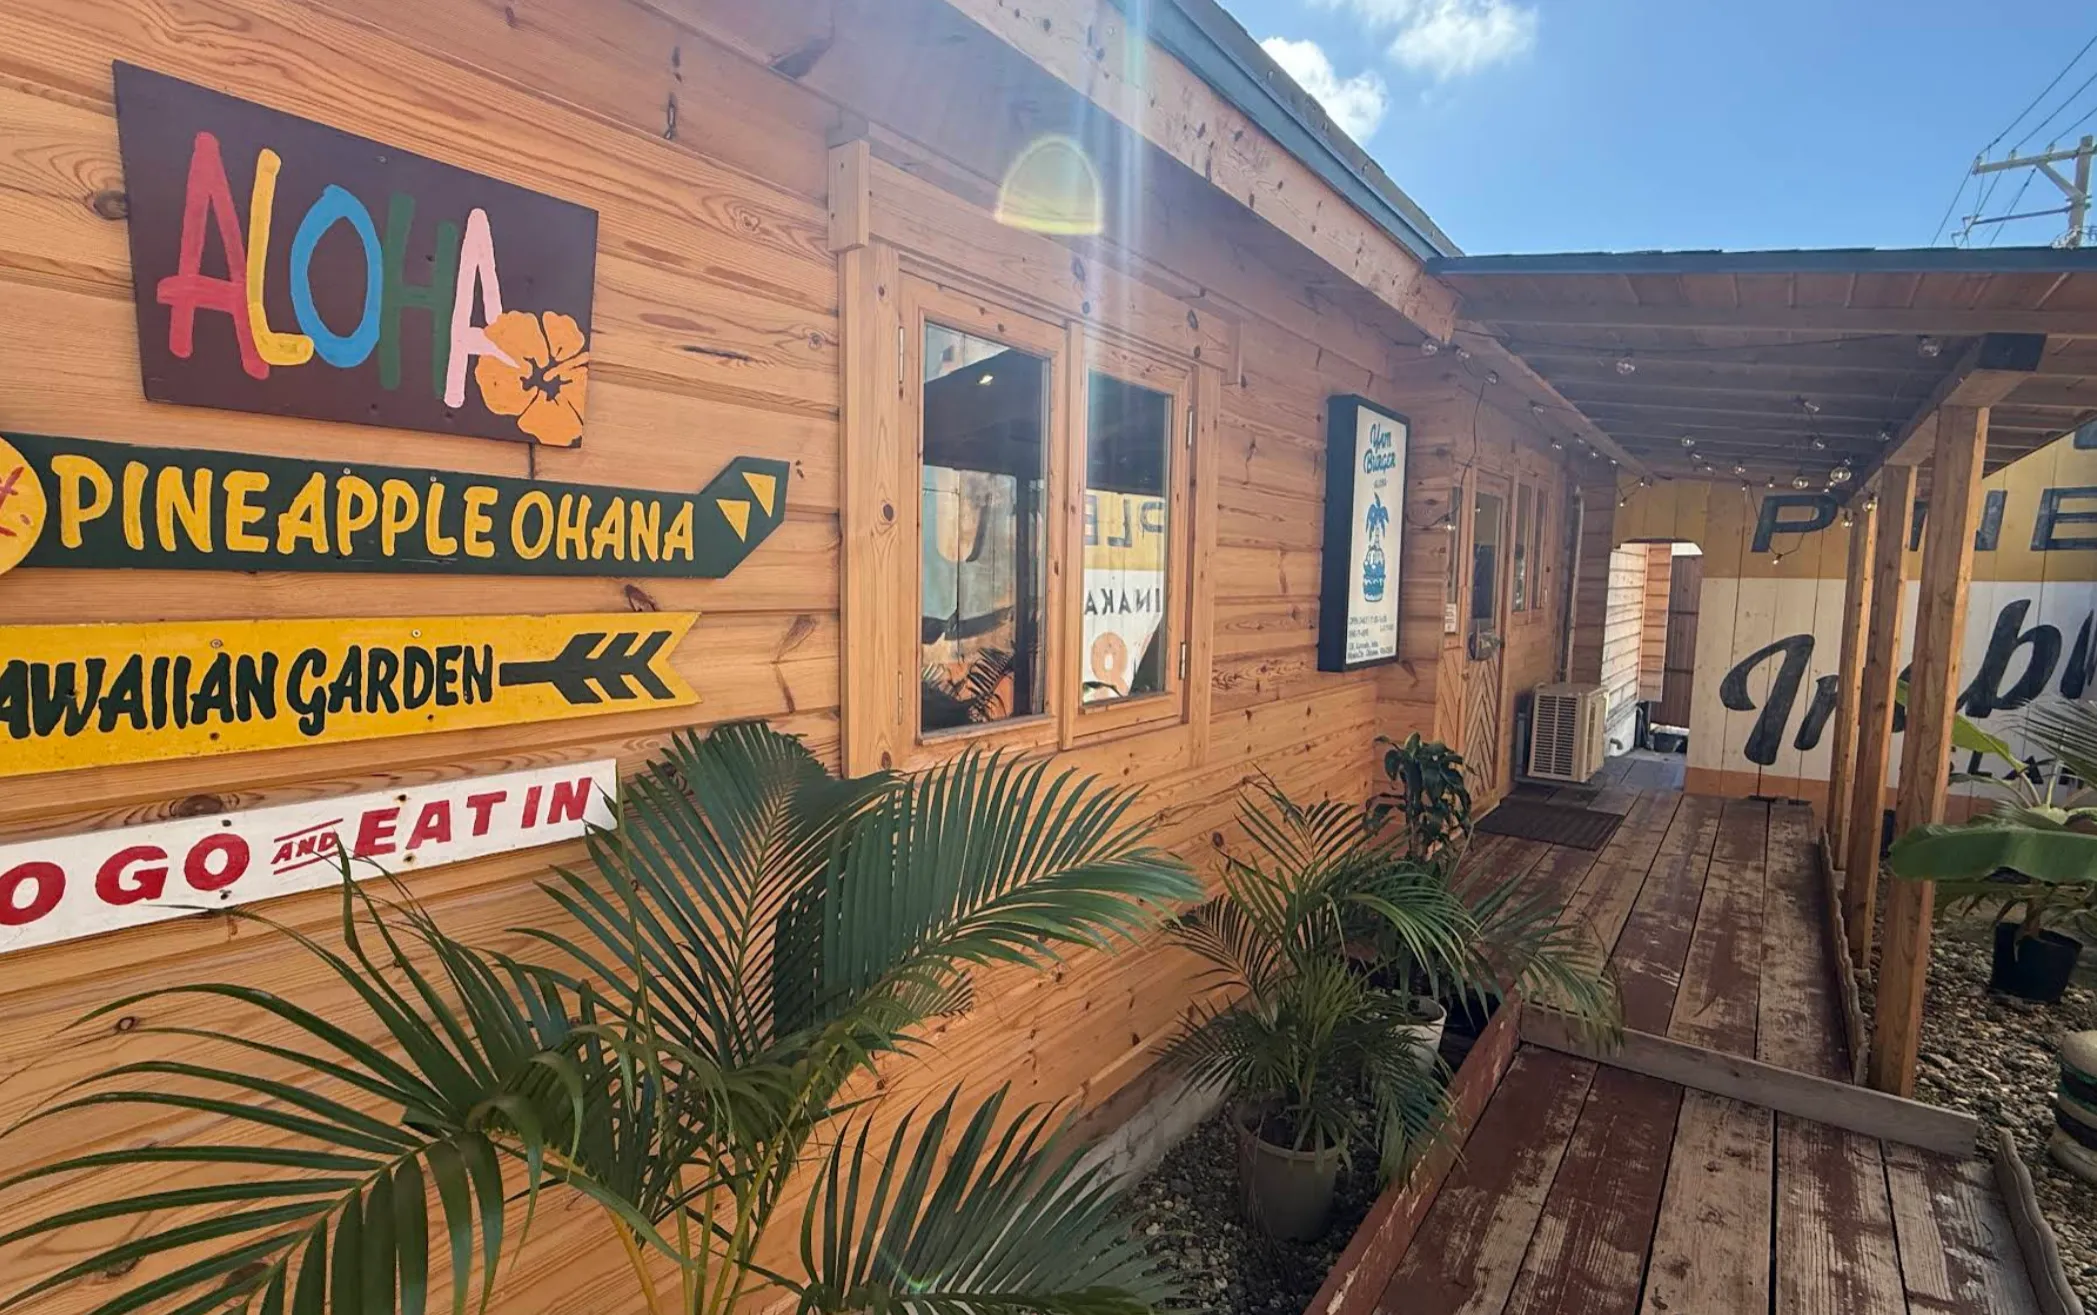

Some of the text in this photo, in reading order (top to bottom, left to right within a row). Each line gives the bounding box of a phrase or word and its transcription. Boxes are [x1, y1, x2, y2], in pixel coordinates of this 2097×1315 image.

[157, 132, 520, 409] ALOHA
[51, 454, 695, 561] PINEAPPLE OHANA
[0, 644, 494, 739] AWAIIAN GARDEN
[0, 778, 593, 925] O GO AND EAT IN
